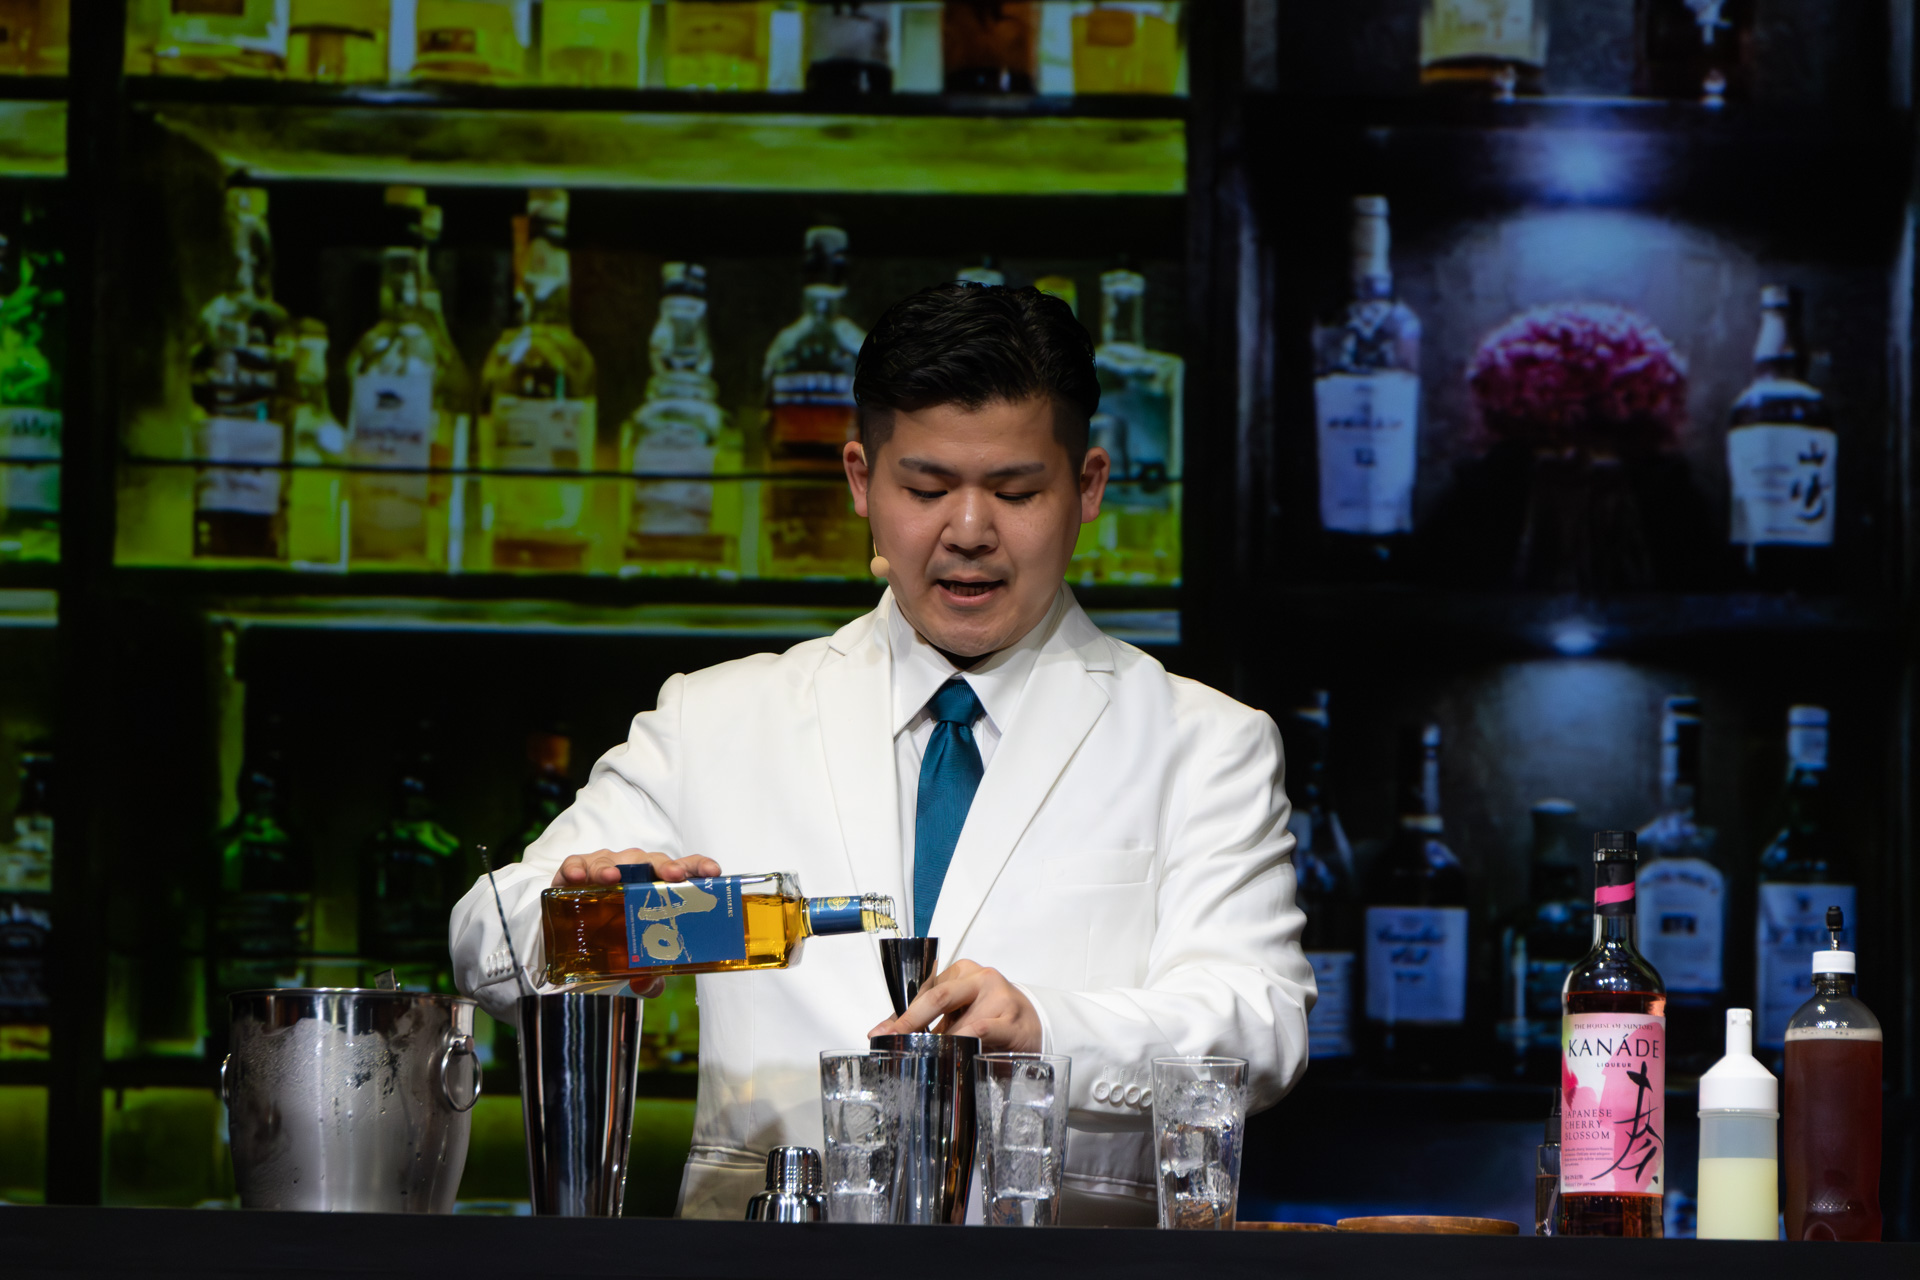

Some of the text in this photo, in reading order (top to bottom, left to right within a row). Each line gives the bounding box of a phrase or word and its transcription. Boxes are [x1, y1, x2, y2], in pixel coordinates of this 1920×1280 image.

[1568, 1033, 1660, 1059] KANÁDE
[1564, 1108, 1613, 1119] JAPANESE
[1564, 1120, 1602, 1130] CHERRY
[1564, 1131, 1610, 1141] BLOSSOM
